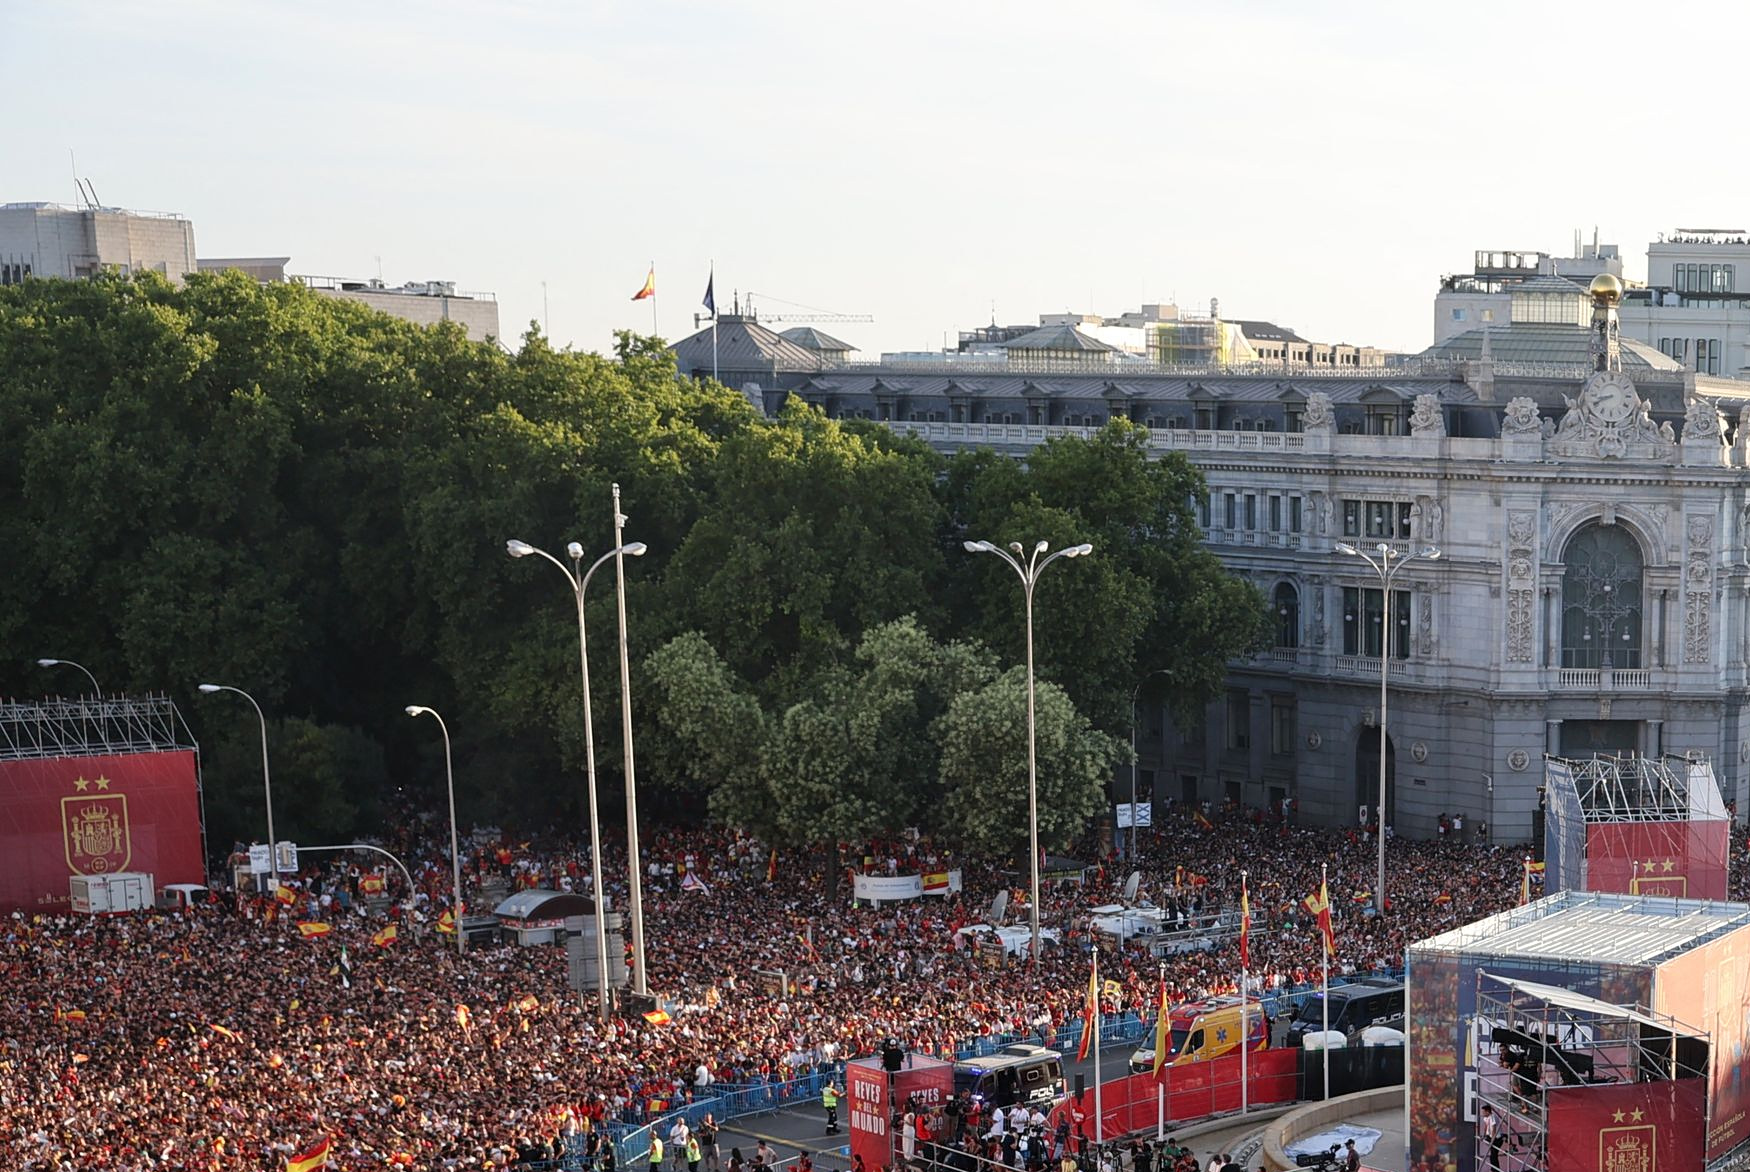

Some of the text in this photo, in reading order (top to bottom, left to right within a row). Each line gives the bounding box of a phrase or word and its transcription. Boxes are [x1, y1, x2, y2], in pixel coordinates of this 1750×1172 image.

[854, 1079, 881, 1104] REYES
[863, 1101, 872, 1113] DEL
[851, 1110, 885, 1136] MUNDO
